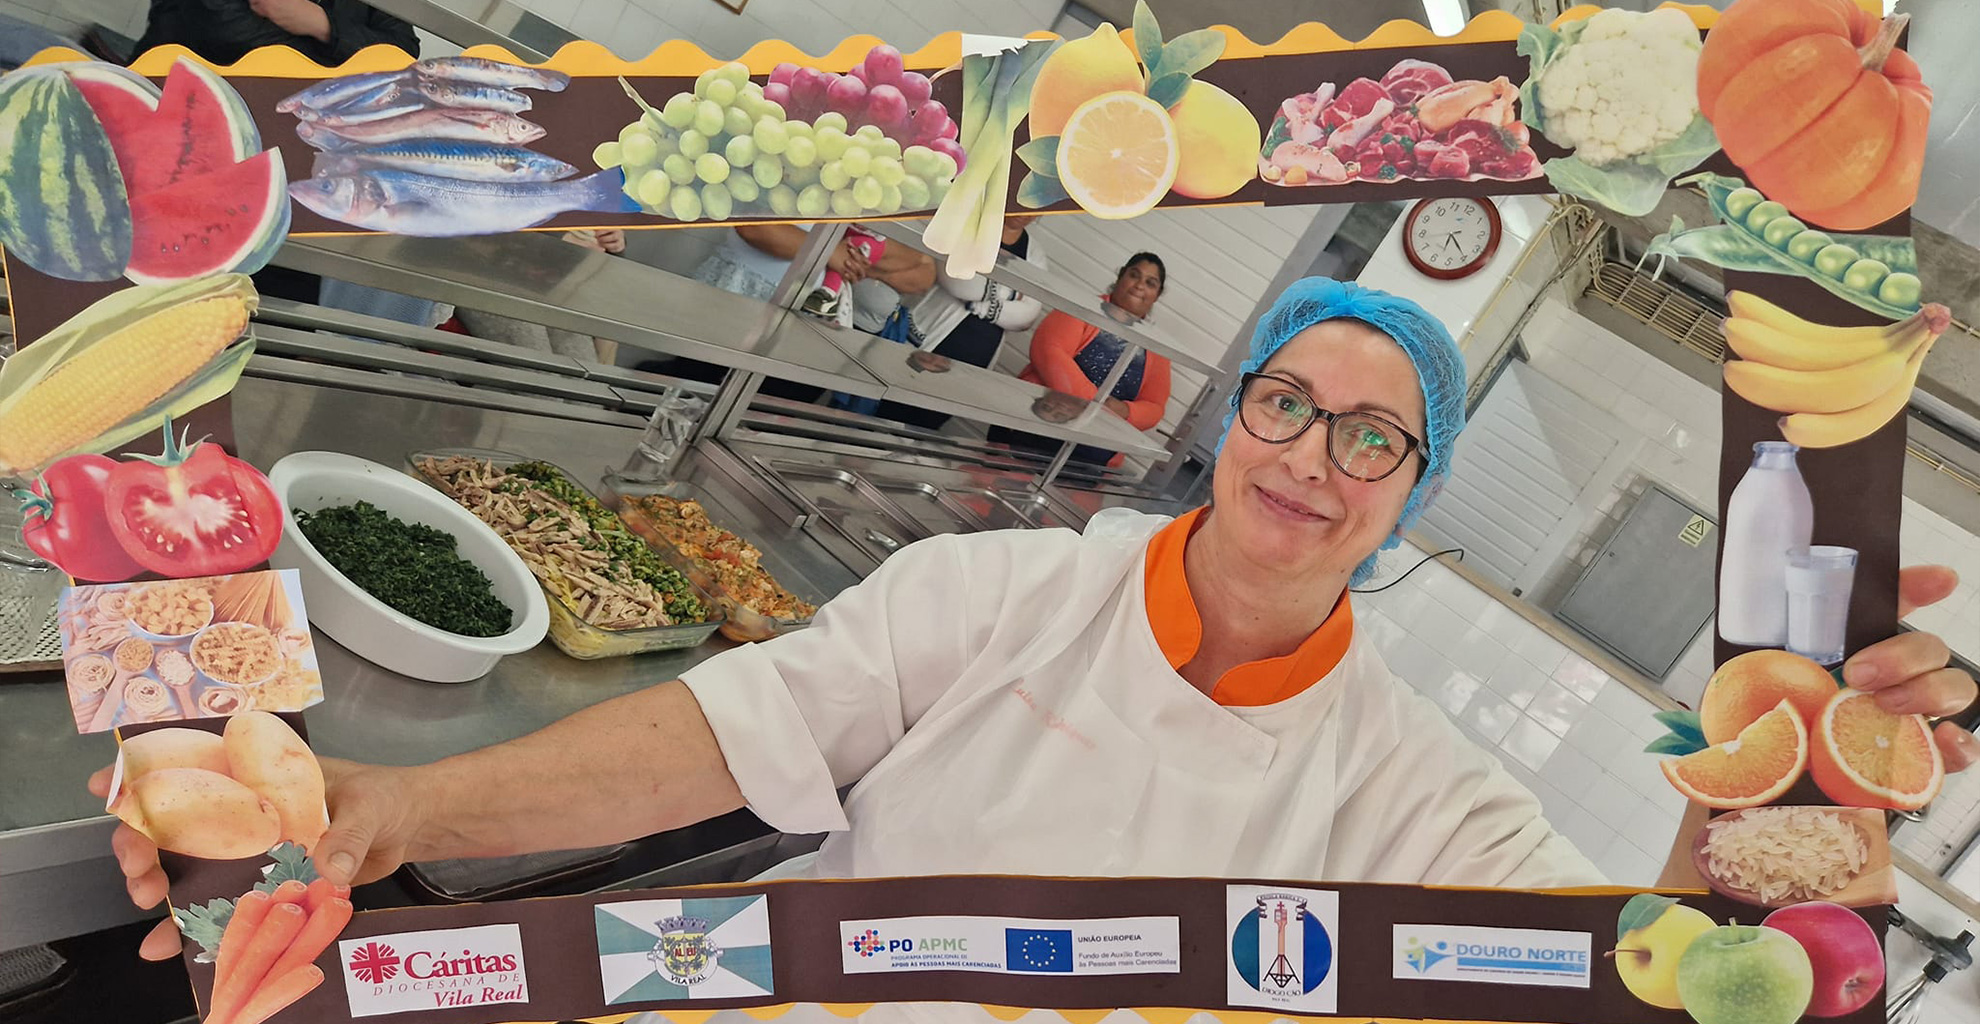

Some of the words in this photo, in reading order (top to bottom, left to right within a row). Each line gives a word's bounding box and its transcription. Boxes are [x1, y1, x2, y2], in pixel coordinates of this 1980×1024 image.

[1435, 206, 1446, 217] 10
[1449, 202, 1460, 212] 11
[1463, 204, 1475, 216] 12
[1422, 215, 1430, 224] 9
[1418, 229, 1427, 238] 8
[1477, 230, 1486, 239] 2
[1421, 242, 1430, 251] 7
[1472, 244, 1481, 254] 3
[1430, 253, 1438, 262] 6
[1444, 257, 1453, 266] 5
[1078, 935, 1102, 943] UNIÃO
[1103, 934, 1142, 942] EUROPEIA
[889, 938, 913, 952] PO
[918, 938, 968, 951] APMC
[1078, 952, 1099, 960] Fundo
[1101, 951, 1109, 959] de
[1134, 950, 1163, 959] Europeu
[1456, 944, 1522, 959] DOURO
[1527, 948, 1586, 962] NORTE
[404, 949, 517, 979] Cáritas
[373, 977, 486, 996] DIOCESANA
[498, 972, 521, 983] DE
[671, 974, 688, 985] VILA
[689, 974, 707, 984] REAL
[434, 989, 473, 1007] Vila
[481, 984, 523, 1003] Real
